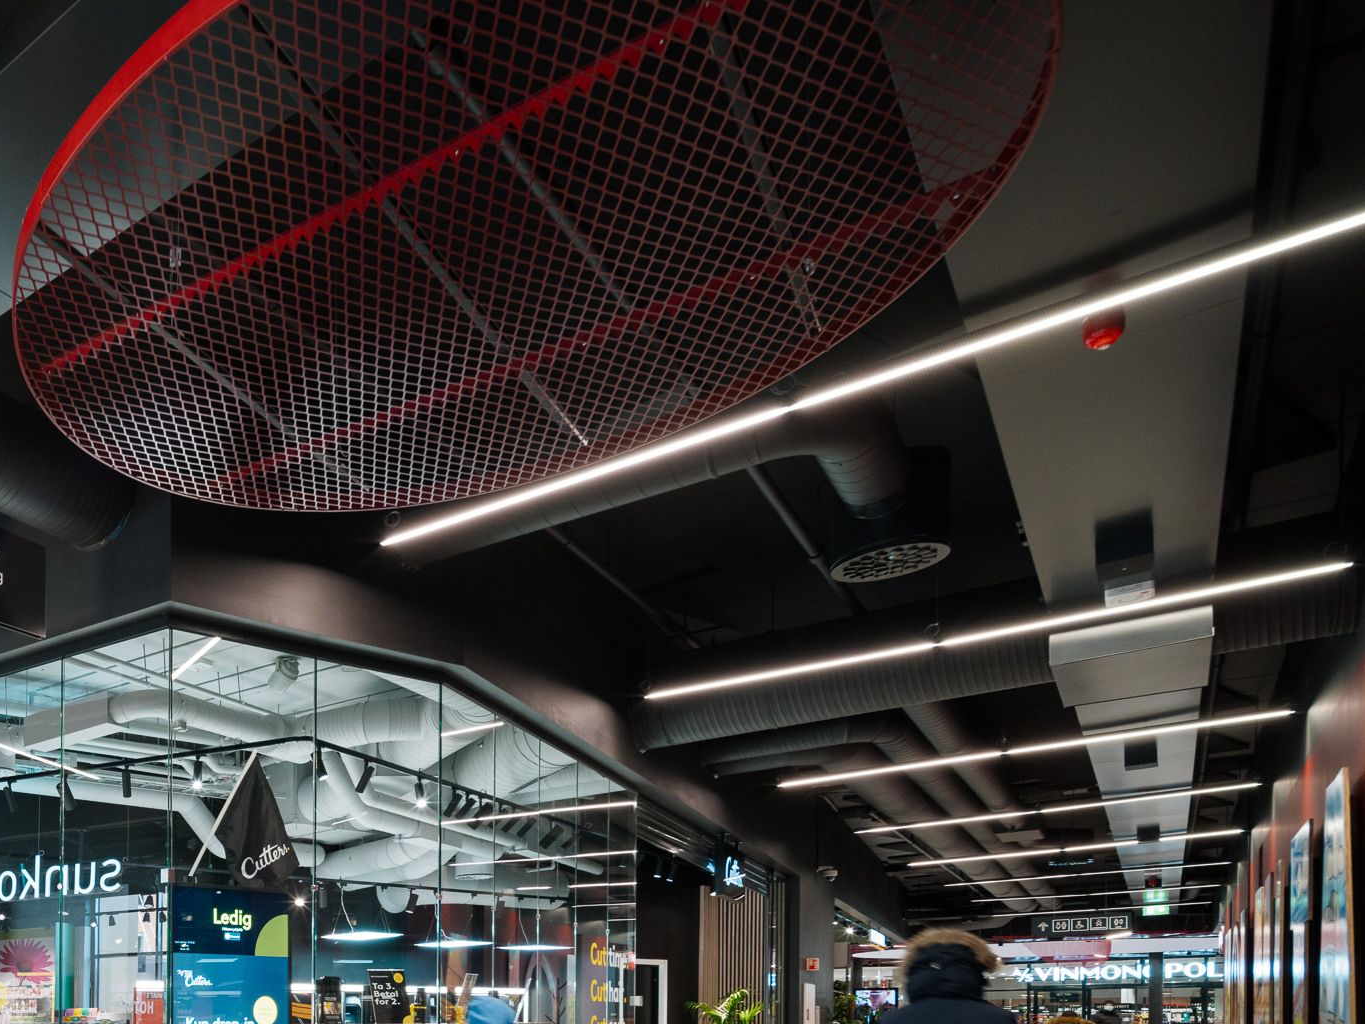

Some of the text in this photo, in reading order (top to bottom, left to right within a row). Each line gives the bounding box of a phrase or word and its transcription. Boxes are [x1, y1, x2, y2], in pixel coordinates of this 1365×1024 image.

[213, 907, 252, 931] Ledig
[590, 942, 606, 966] Cut
[372, 982, 396, 990] Ta 3.
[373, 990, 399, 998] Betal
[590, 978, 606, 1003] Cut
